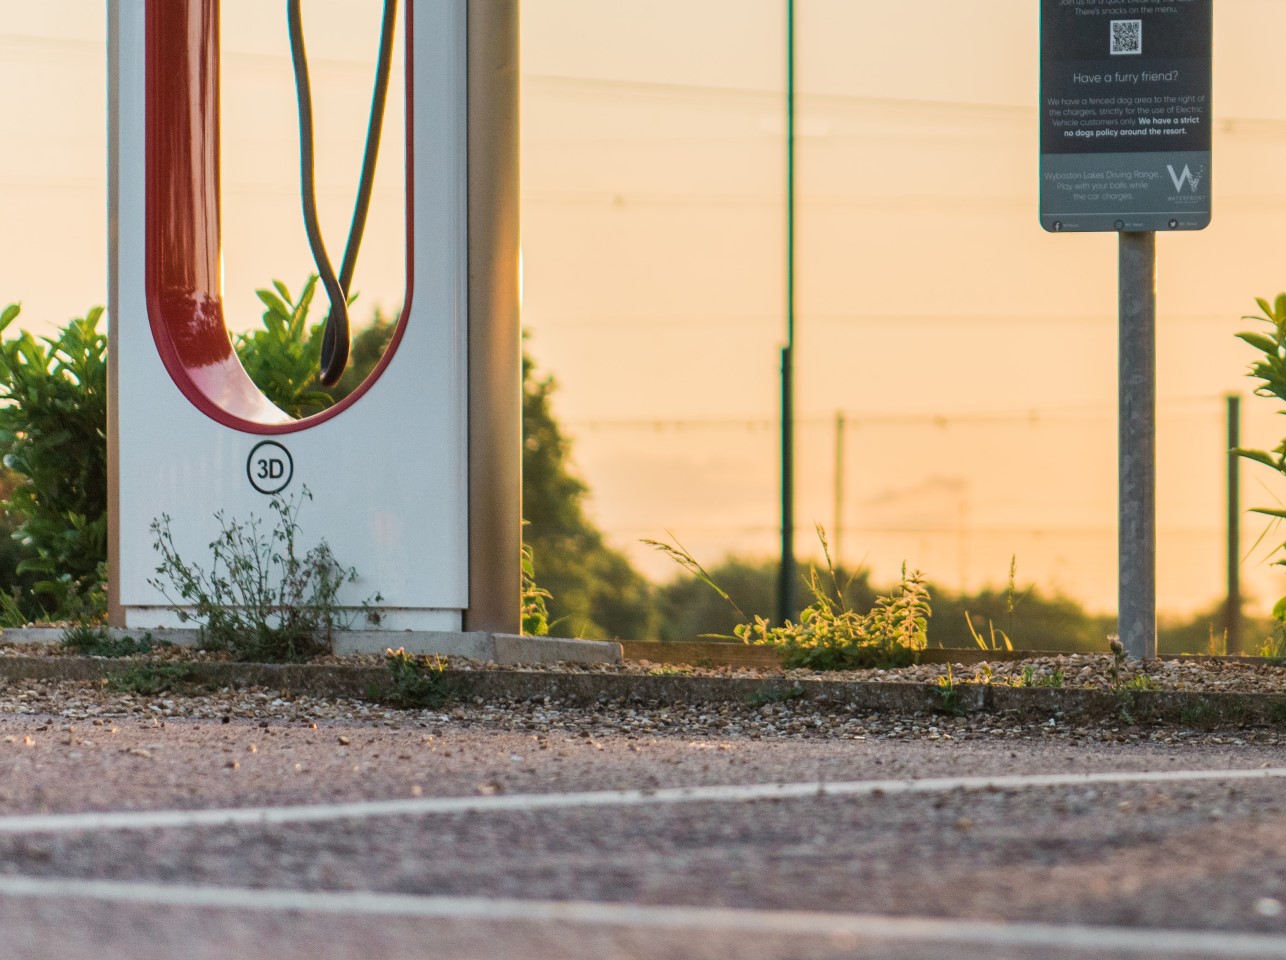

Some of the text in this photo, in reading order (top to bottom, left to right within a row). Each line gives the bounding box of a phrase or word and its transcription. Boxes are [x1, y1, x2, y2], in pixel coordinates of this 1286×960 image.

[1102, 7, 1127, 15] snacks
[1073, 70, 1178, 84] Have a furry friend?
[1117, 97, 1132, 105] dog
[1178, 95, 1196, 104] right
[1099, 107, 1123, 116] strictly
[1053, 118, 1078, 126] Vehicle
[1080, 118, 1119, 126] customers
[1075, 129, 1094, 138] dogs
[1095, 129, 1118, 137] policy
[1120, 128, 1147, 136] around
[1083, 171, 1104, 179] Lakes
[1106, 170, 1132, 179] Driving
[1057, 182, 1072, 190] Play
[1092, 182, 1108, 190] your
[1110, 181, 1128, 189] balls
[257, 458, 284, 480] 3D
